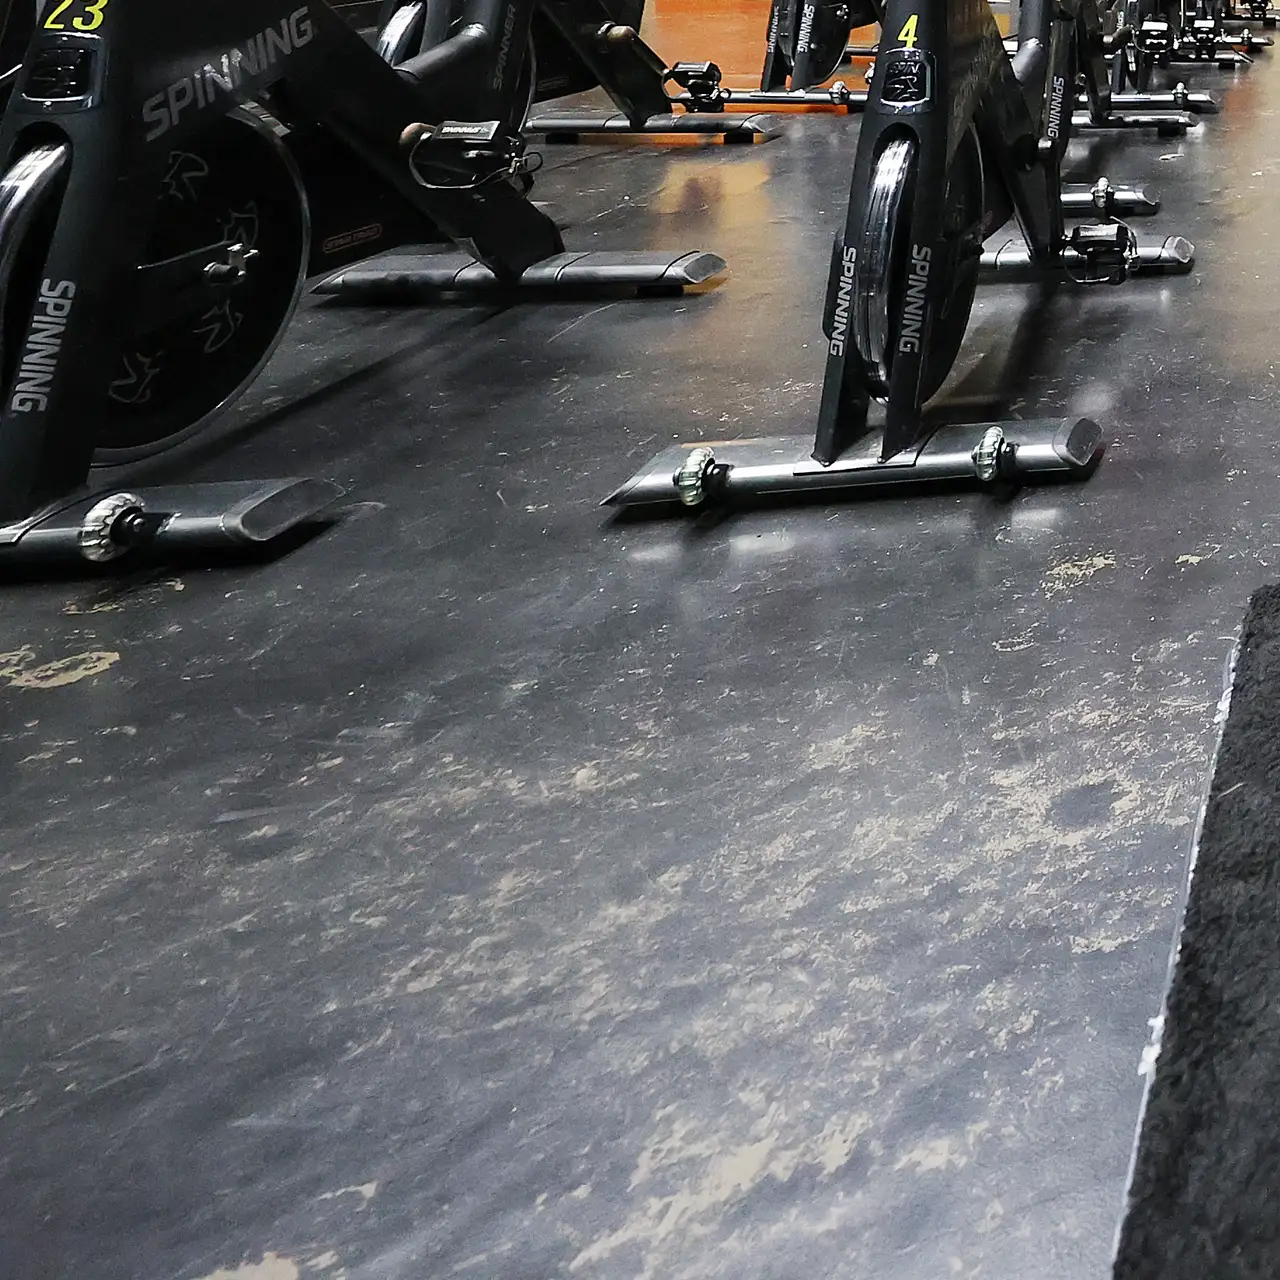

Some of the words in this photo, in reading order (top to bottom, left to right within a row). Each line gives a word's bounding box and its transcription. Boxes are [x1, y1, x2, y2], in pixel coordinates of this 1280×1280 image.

[141, 5, 315, 142] SPINNING
[797, 3, 815, 54] SPINNING
[897, 13, 920, 49] 4
[1047, 75, 1066, 139] SPINNING
[11, 278, 77, 413] SPINNING
[829, 245, 858, 358] SPINNING
[899, 243, 932, 354] SPINNING
